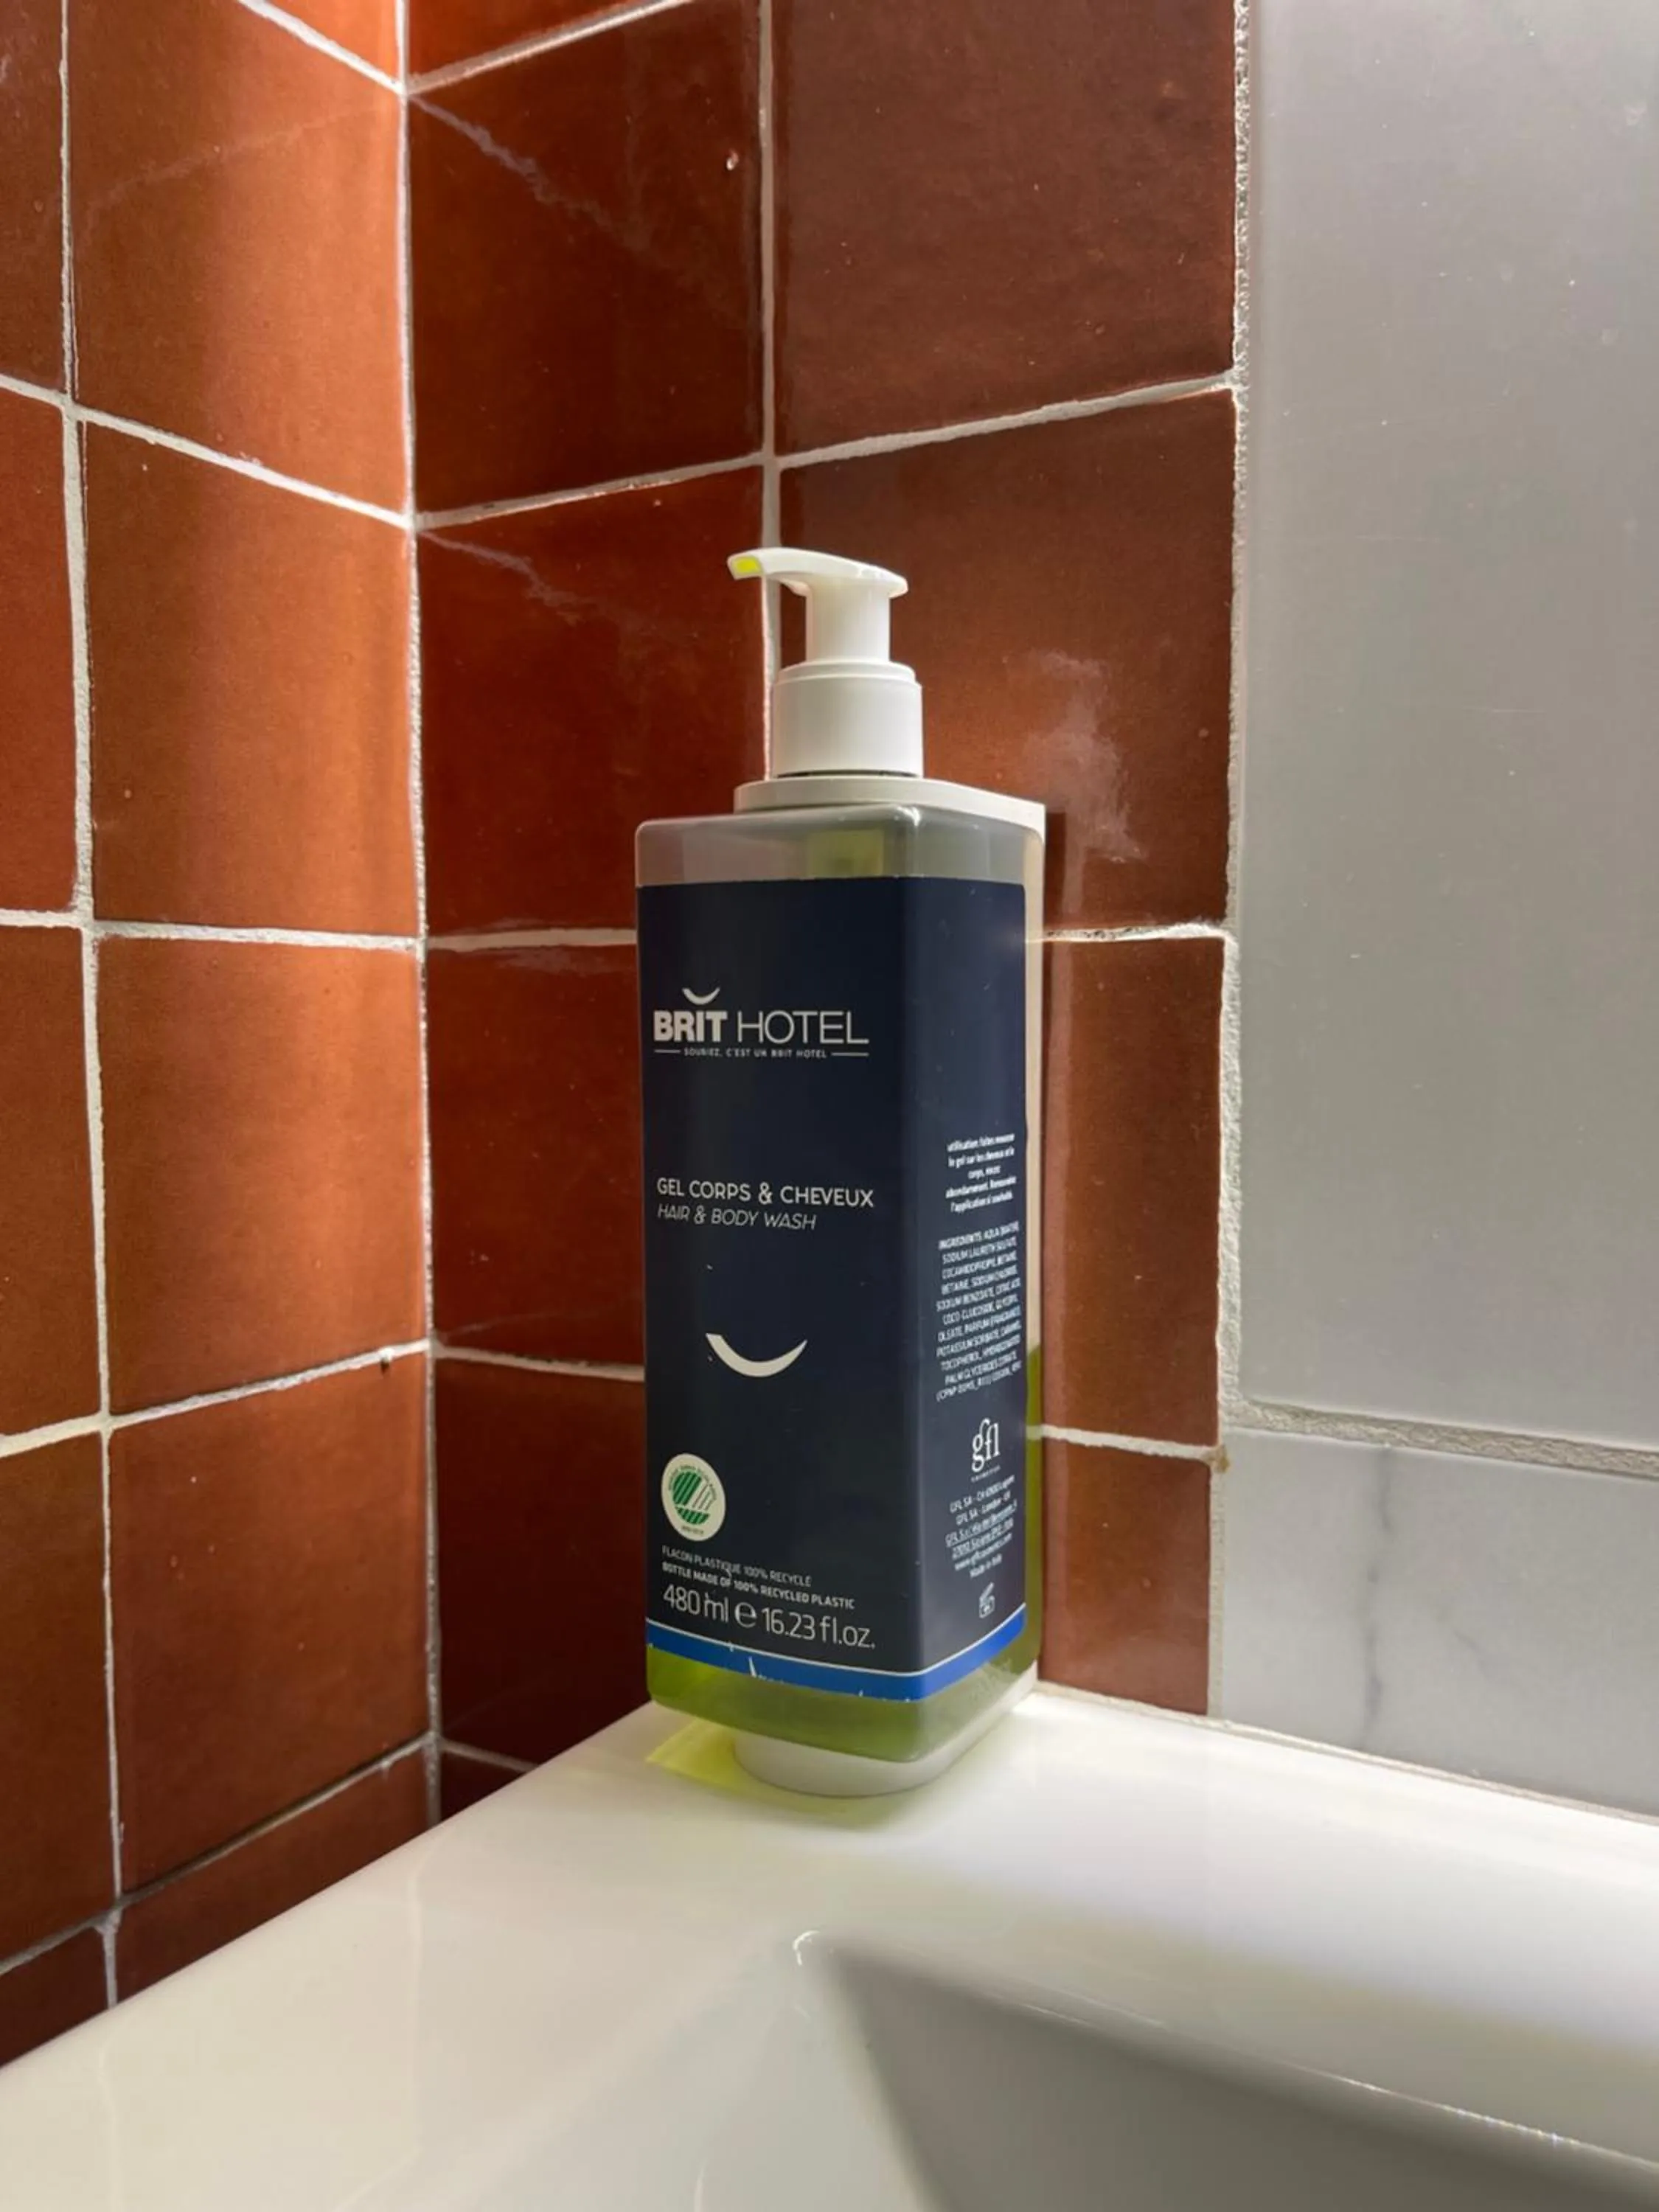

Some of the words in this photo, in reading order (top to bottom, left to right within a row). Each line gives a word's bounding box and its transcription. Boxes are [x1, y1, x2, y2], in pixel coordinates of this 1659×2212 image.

[654, 1011, 728, 1043] BRIT
[737, 1011, 869, 1044] HOTEL
[657, 1178, 684, 1197] GEL
[689, 1180, 751, 1202] CORPS
[758, 1182, 773, 1205] &
[780, 1186, 874, 1208] CHEVEUX
[658, 1204, 689, 1222] HAIR
[695, 1206, 706, 1224] &
[711, 1208, 759, 1227] BODY
[763, 1212, 816, 1230] WASH
[971, 1417, 1000, 1472] gfl
[662, 1545, 692, 1563] FLACON
[695, 1554, 740, 1574] PLASTIQUE
[743, 1565, 768, 1579] 100%
[662, 1561, 691, 1579] BOTTLE
[693, 1570, 718, 1585] MADE
[720, 1576, 731, 1587] OF
[734, 1580, 758, 1594] 100%
[760, 1585, 809, 1604] RECYCLED
[811, 1593, 855, 1610] PLASTIC
[663, 1584, 700, 1615] 480
[762, 1607, 816, 1641] 16.23
[819, 1615, 875, 1649] fl.oz.
